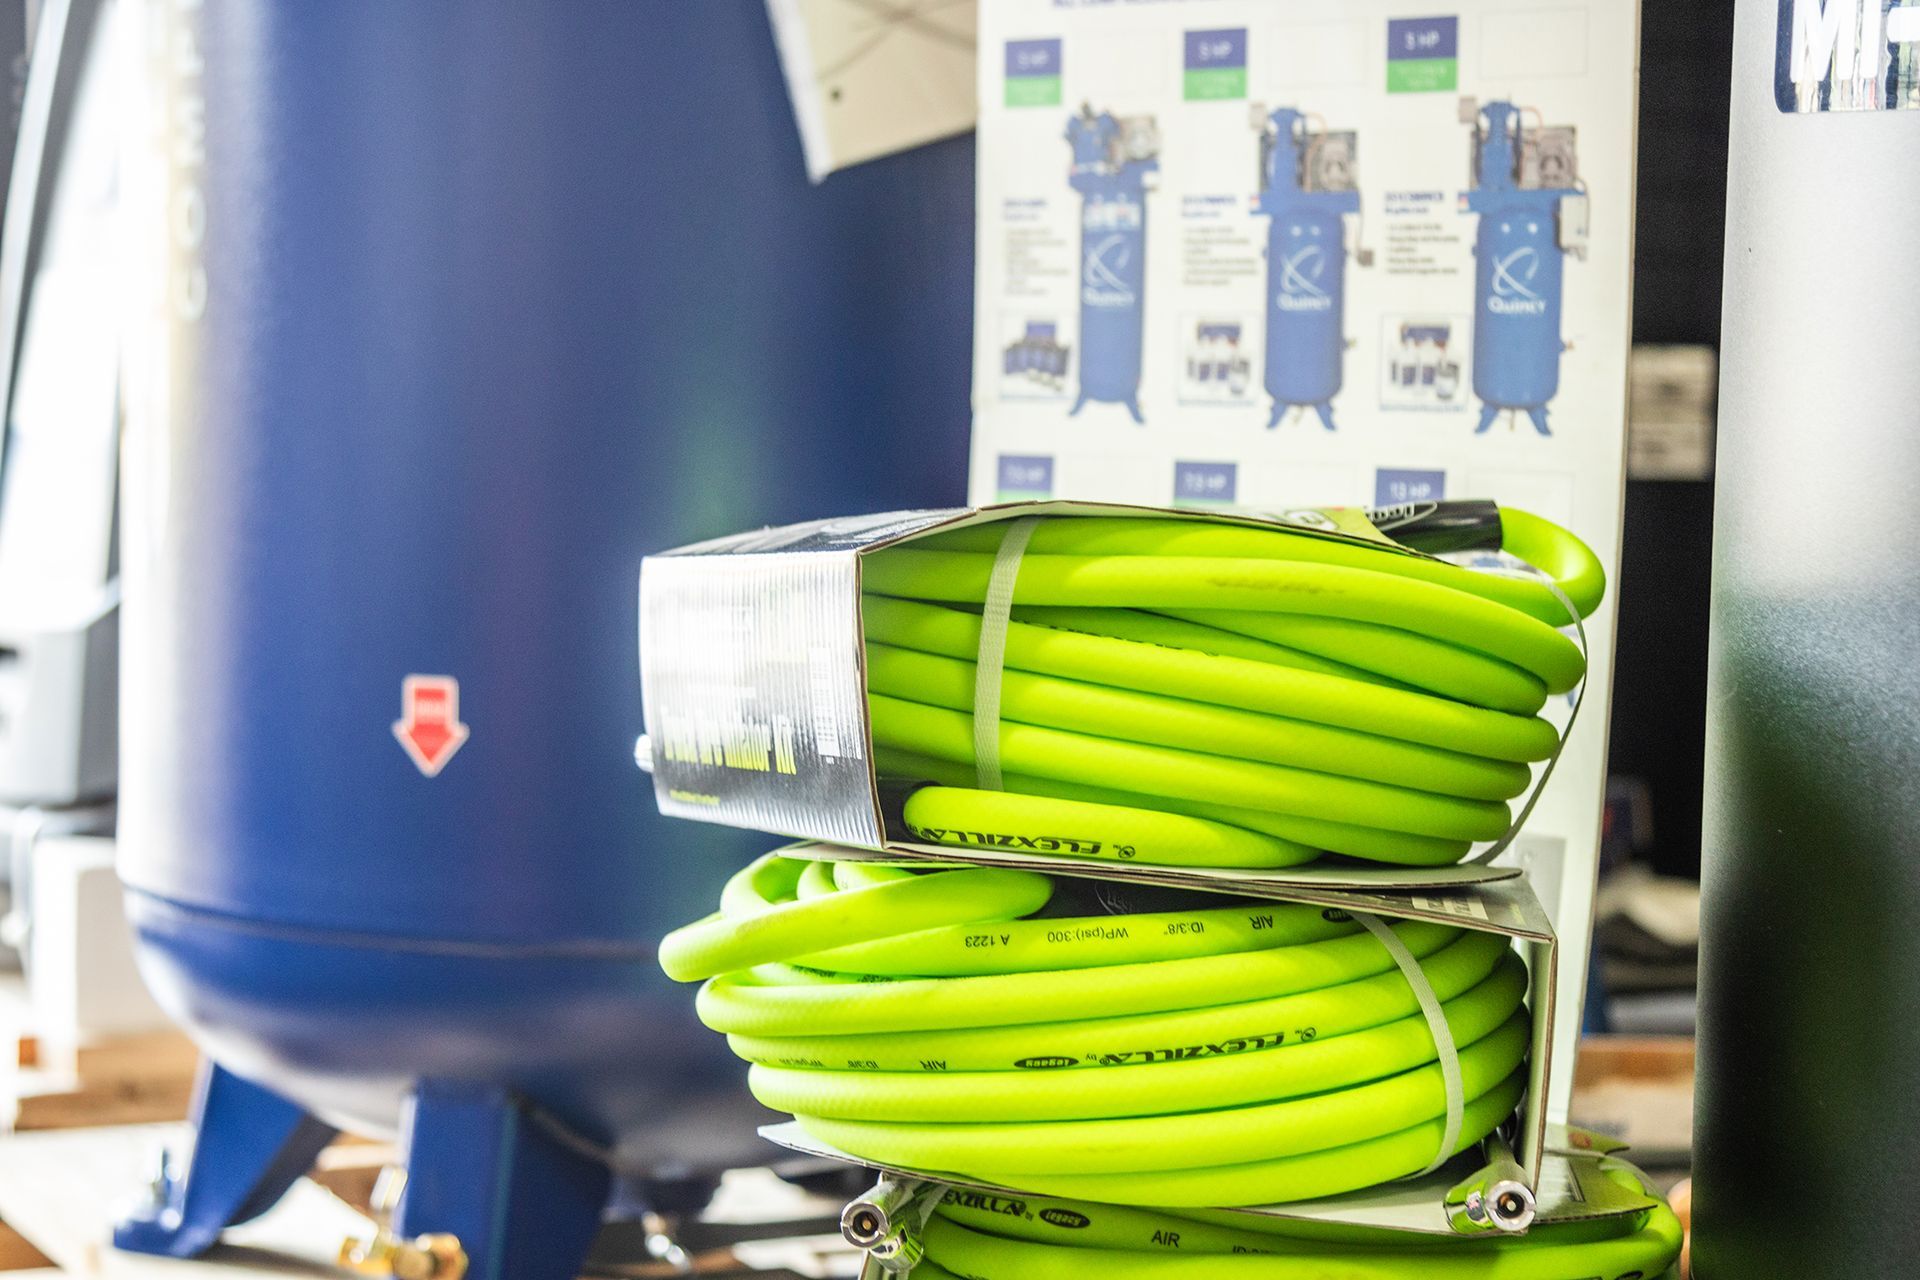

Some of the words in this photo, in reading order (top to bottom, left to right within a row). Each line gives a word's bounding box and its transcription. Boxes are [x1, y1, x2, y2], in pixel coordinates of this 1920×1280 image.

[1249, 915, 1274, 930] AIR
[965, 935, 995, 948] 1223
[1001, 934, 1010, 946] A
[1047, 927, 1130, 943] WP(psi):300
[919, 1060, 947, 1070] AIR
[1044, 1210, 1083, 1226] Legacy
[1151, 1229, 1180, 1248] AIR
